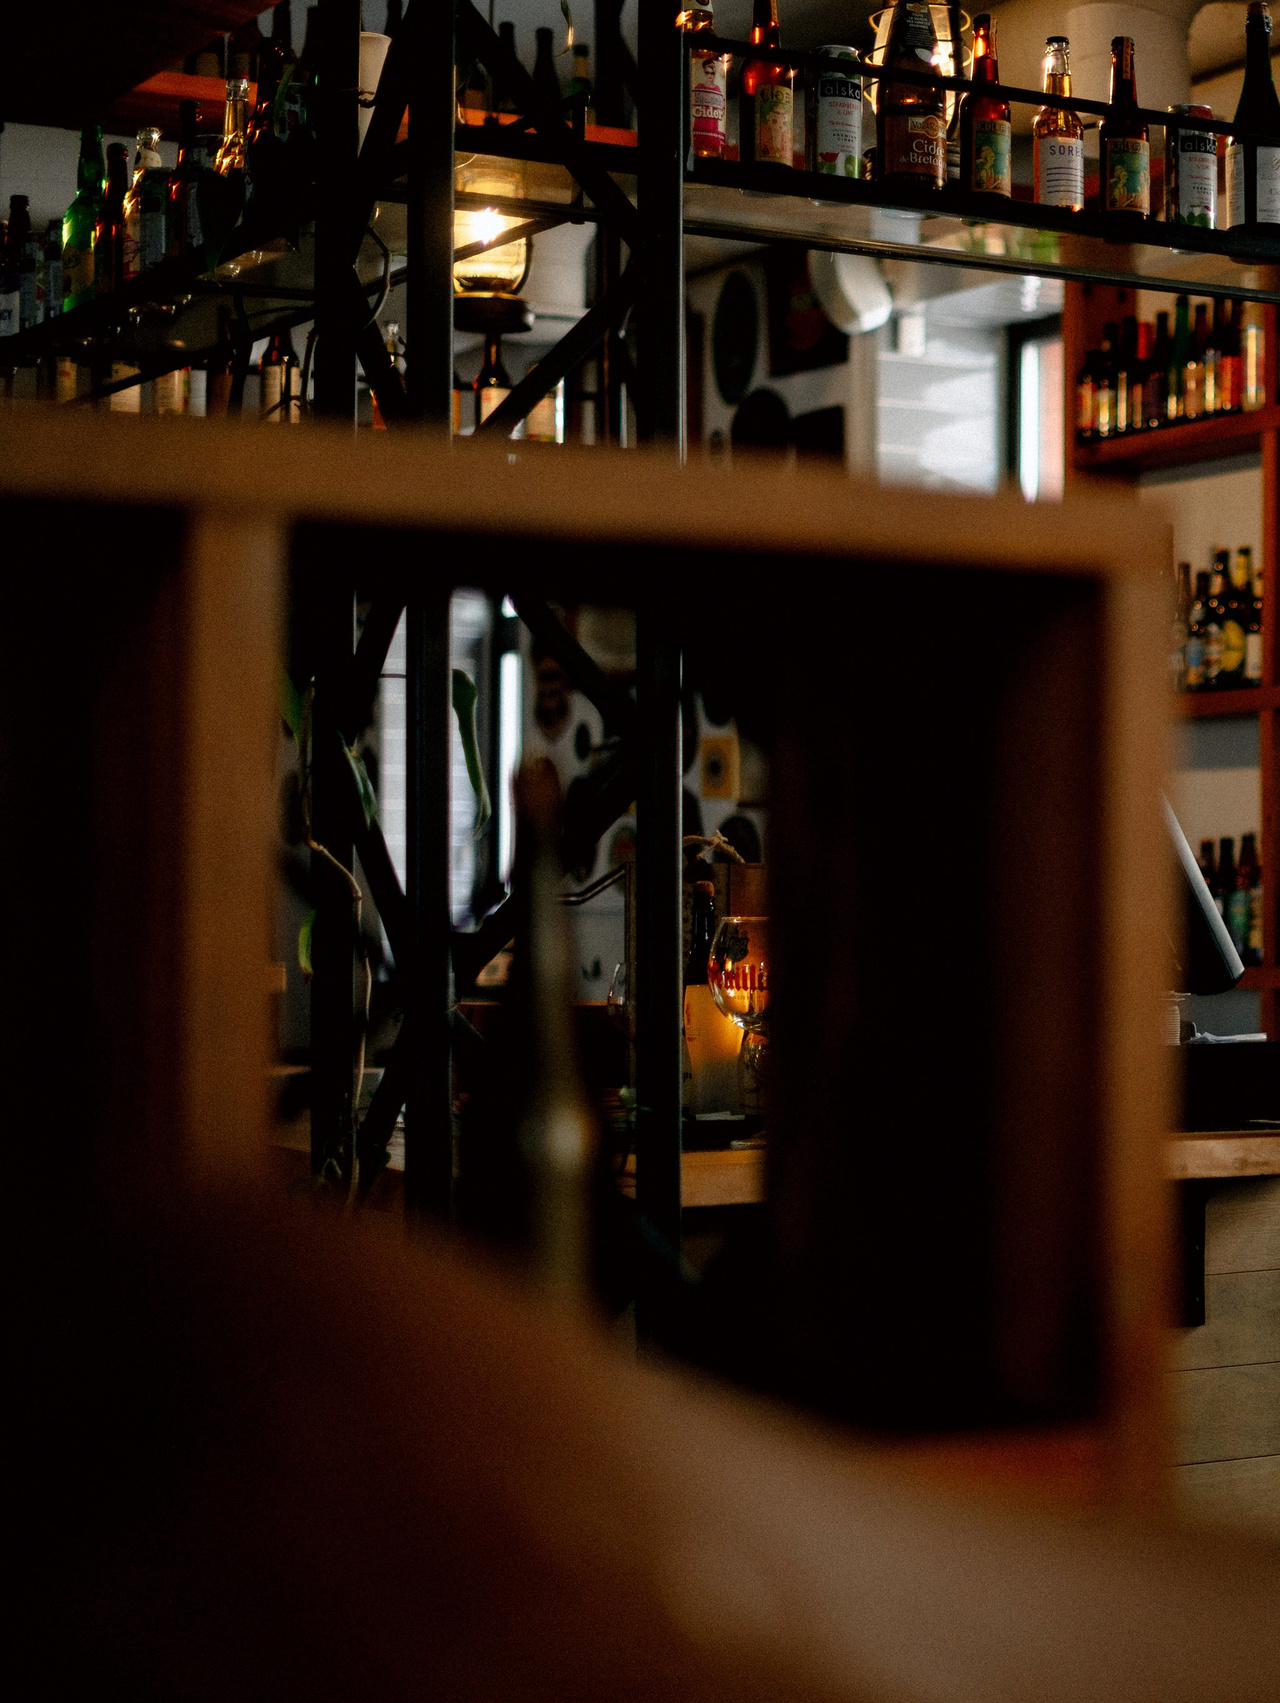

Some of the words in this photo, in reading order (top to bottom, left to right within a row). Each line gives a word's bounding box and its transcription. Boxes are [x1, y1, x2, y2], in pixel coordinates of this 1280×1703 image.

[825, 83, 861, 99] älska
[694, 106, 723, 120] Cider
[913, 140, 944, 157] Cidre
